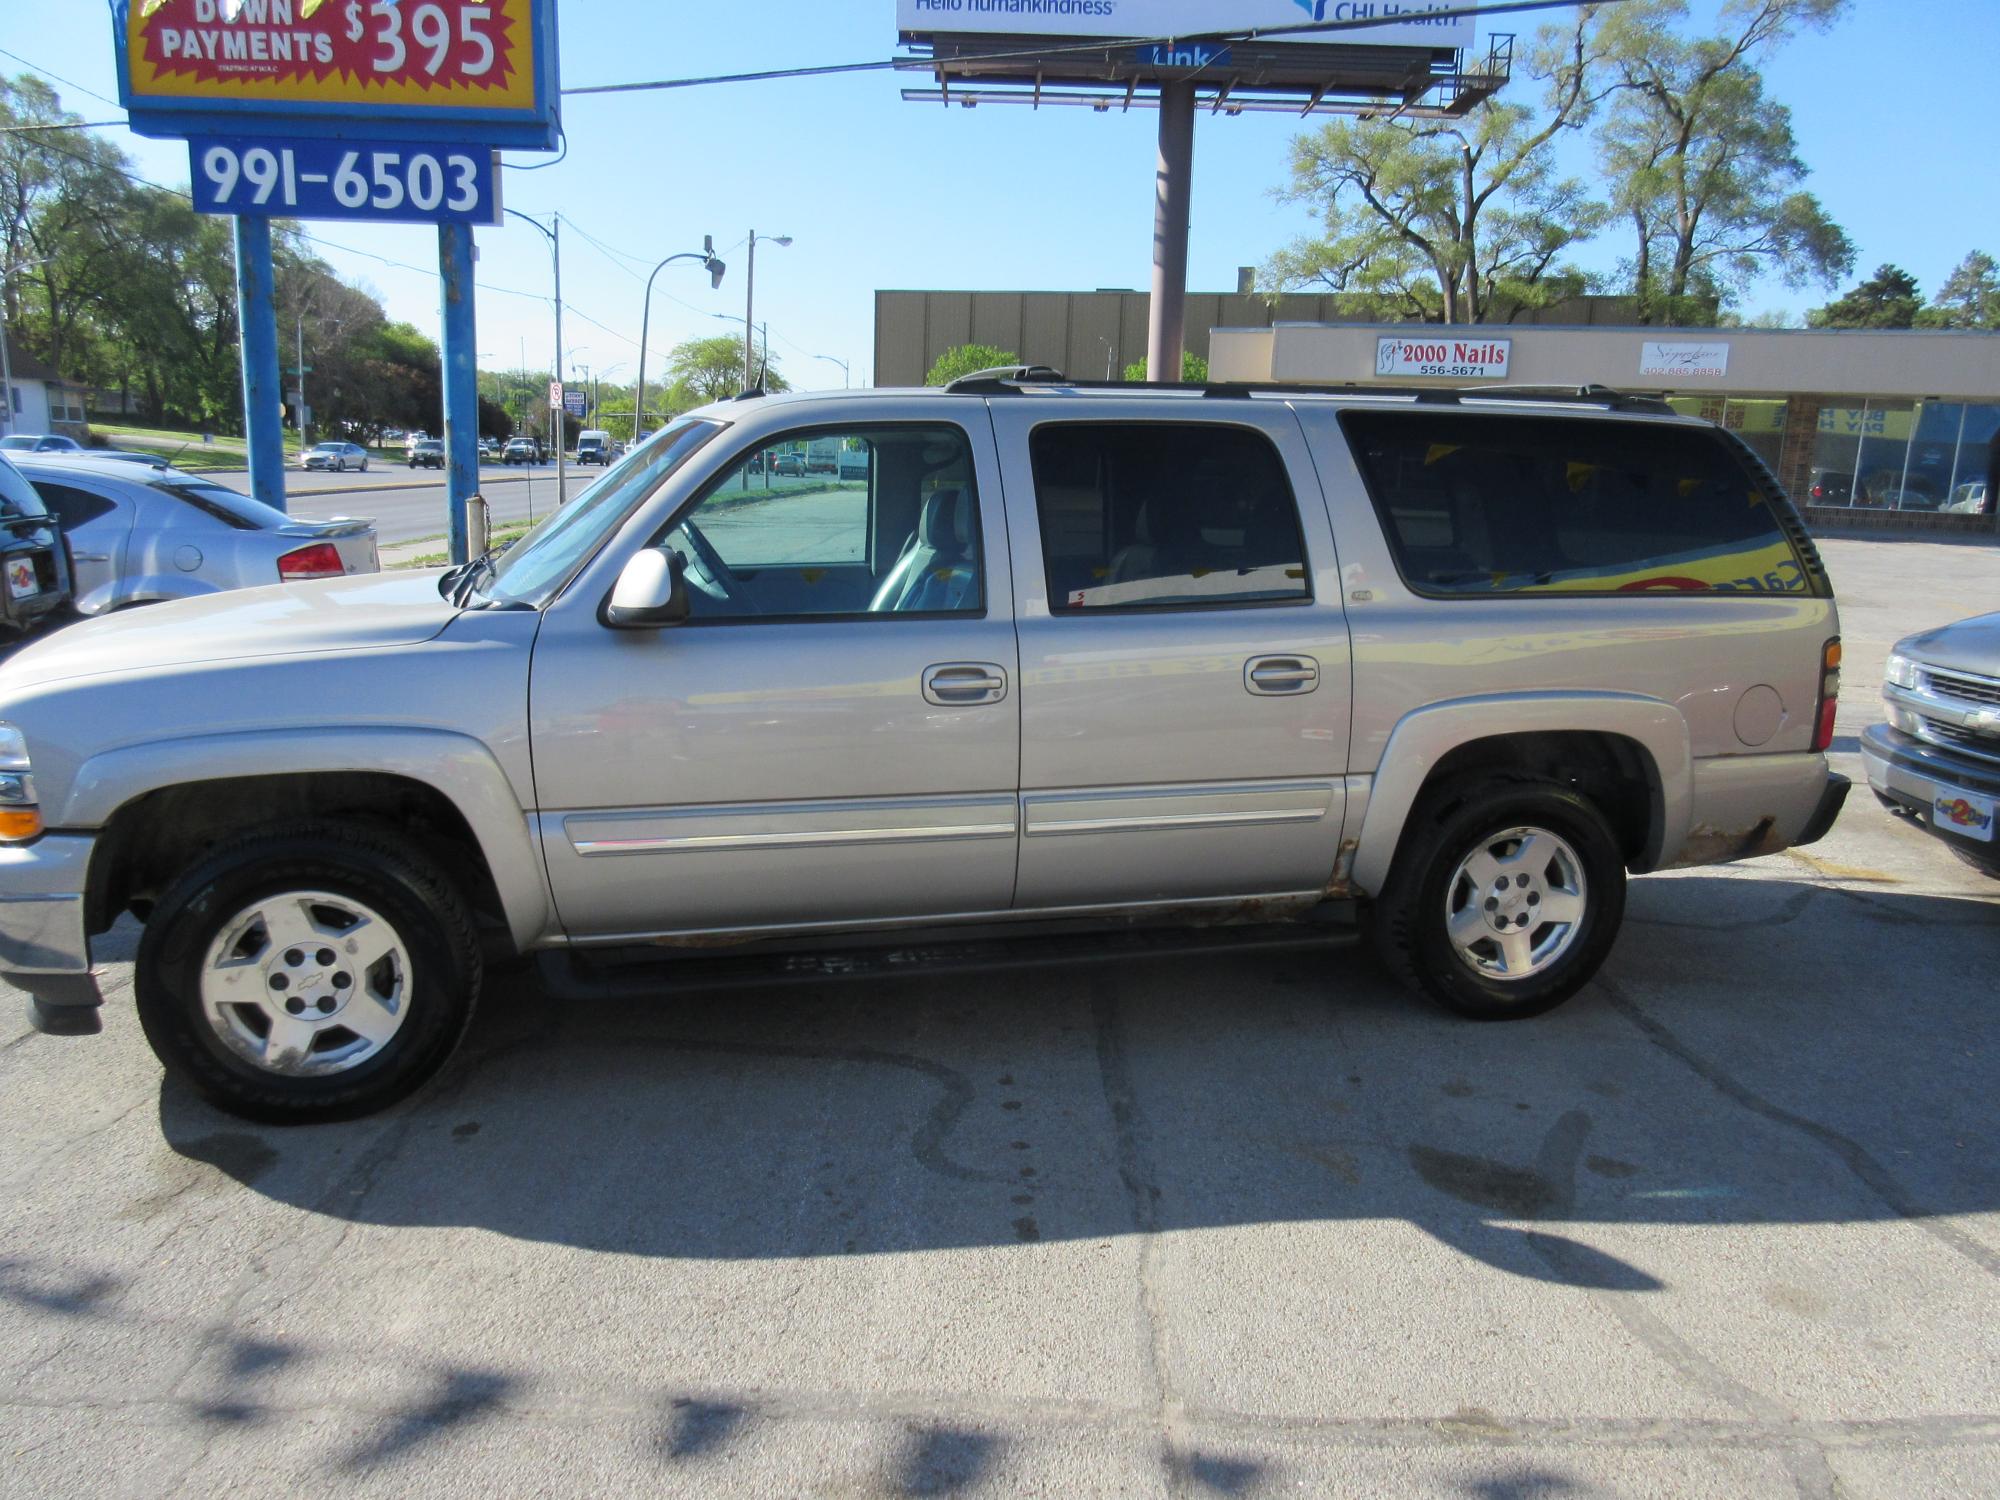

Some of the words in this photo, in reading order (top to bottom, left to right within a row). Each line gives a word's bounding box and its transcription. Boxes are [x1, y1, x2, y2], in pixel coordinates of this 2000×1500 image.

[1335, 3, 1374, 21] CHI
[161, 28, 333, 63] PAYMENTS
[1153, 45, 1210, 66] Link
[203, 147, 479, 211] 991-6503
[1403, 344, 1447, 362] 2000
[1452, 343, 1504, 364] Nails
[1420, 365, 1484, 376] 556-5671
